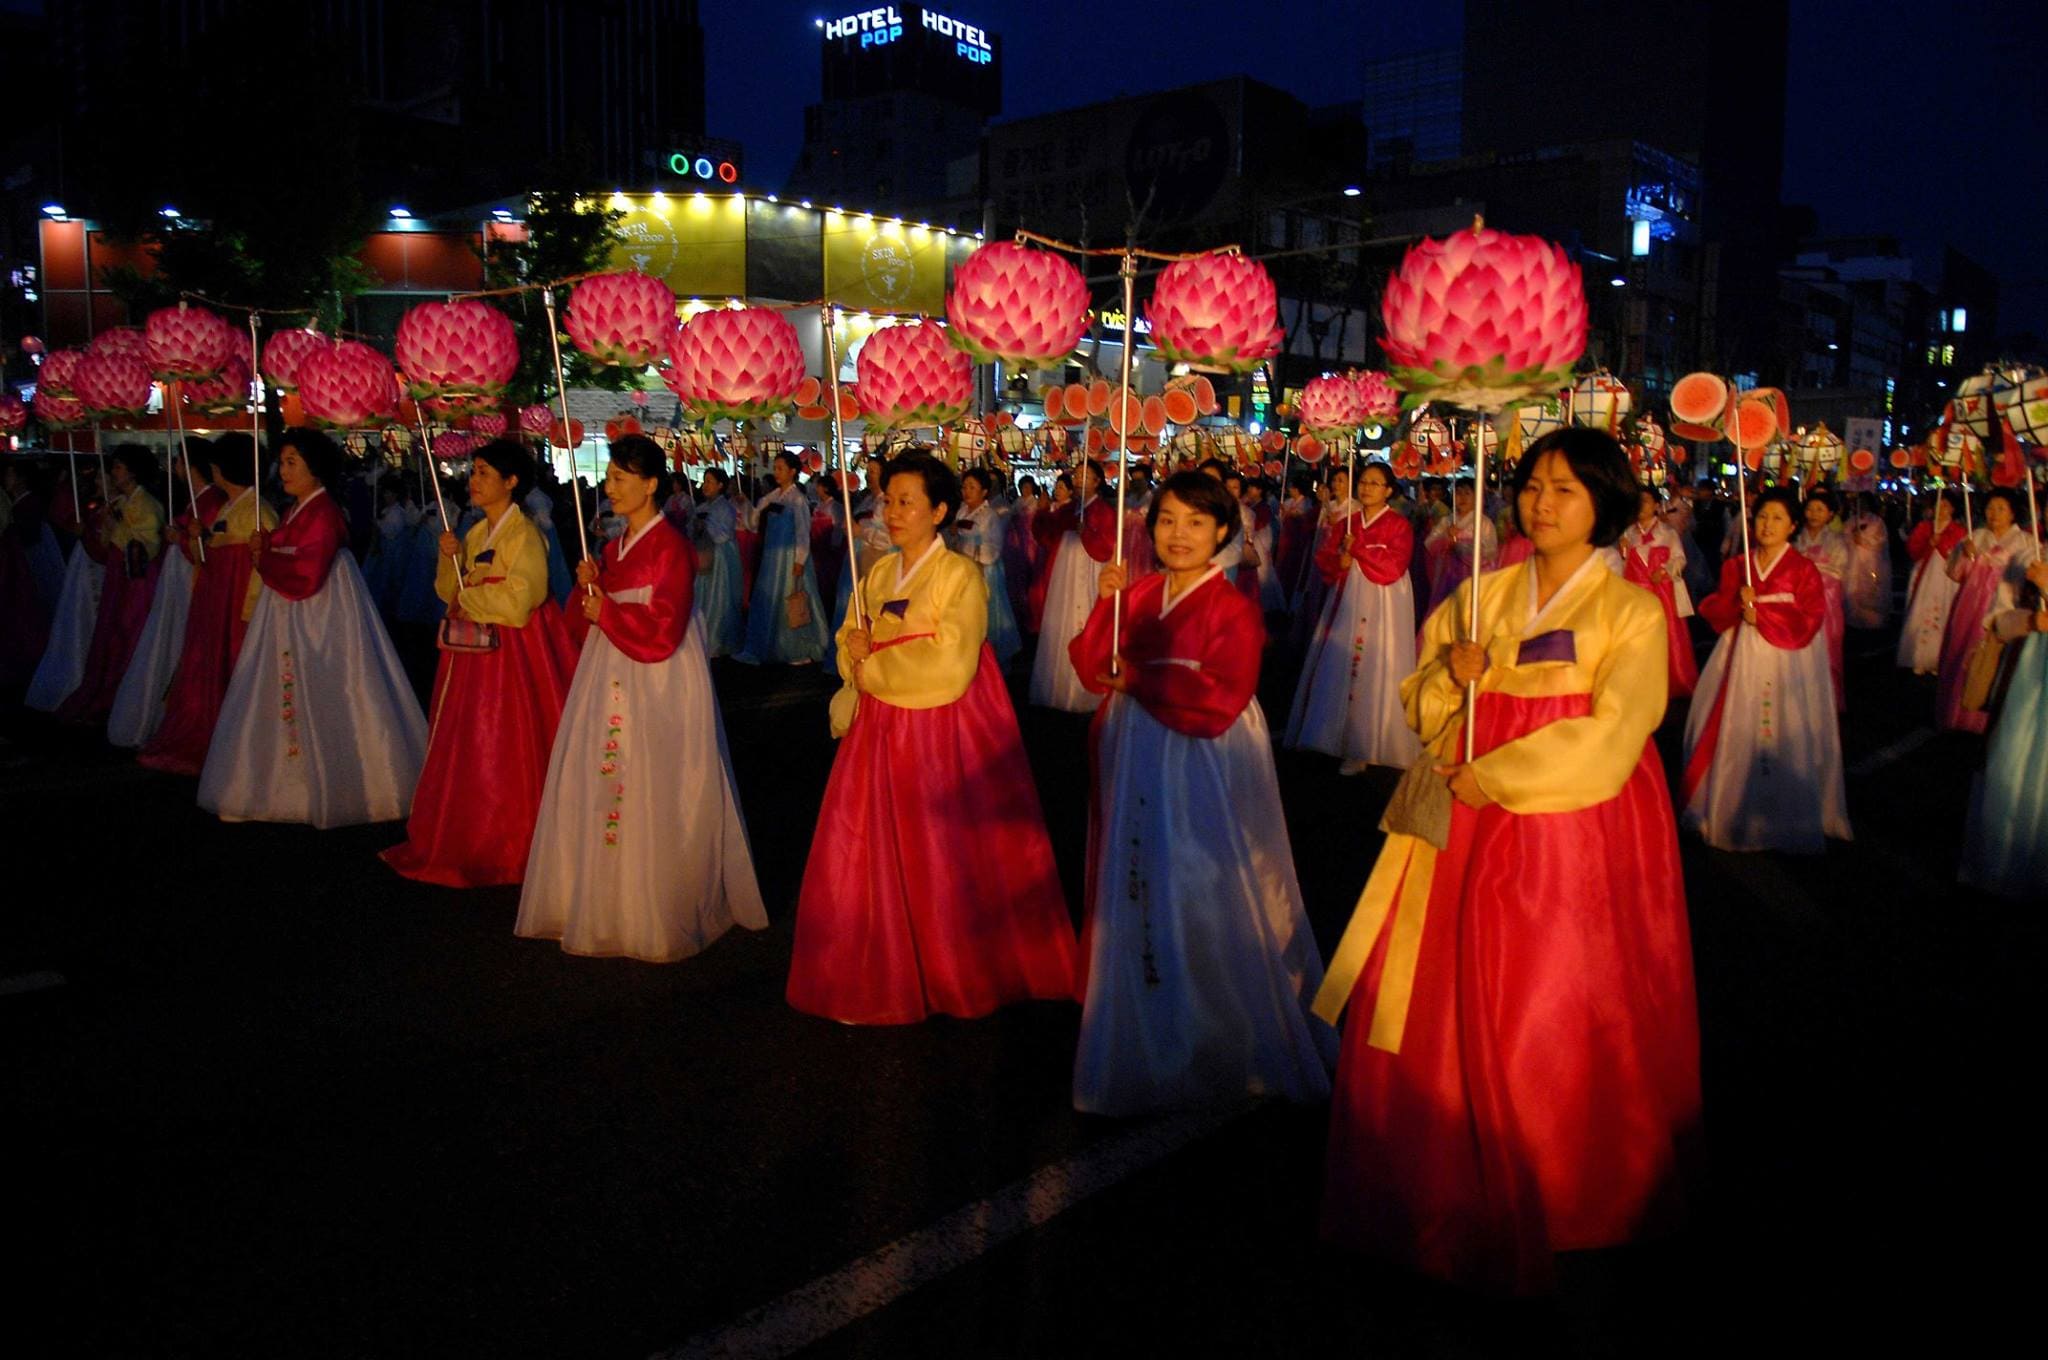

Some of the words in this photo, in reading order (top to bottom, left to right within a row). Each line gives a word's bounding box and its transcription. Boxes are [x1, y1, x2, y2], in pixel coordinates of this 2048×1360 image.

[826, 6, 902, 40] HOTEL
[861, 25, 902, 48] POP
[922, 8, 991, 50] HOTEL
[957, 42, 992, 64] POP
